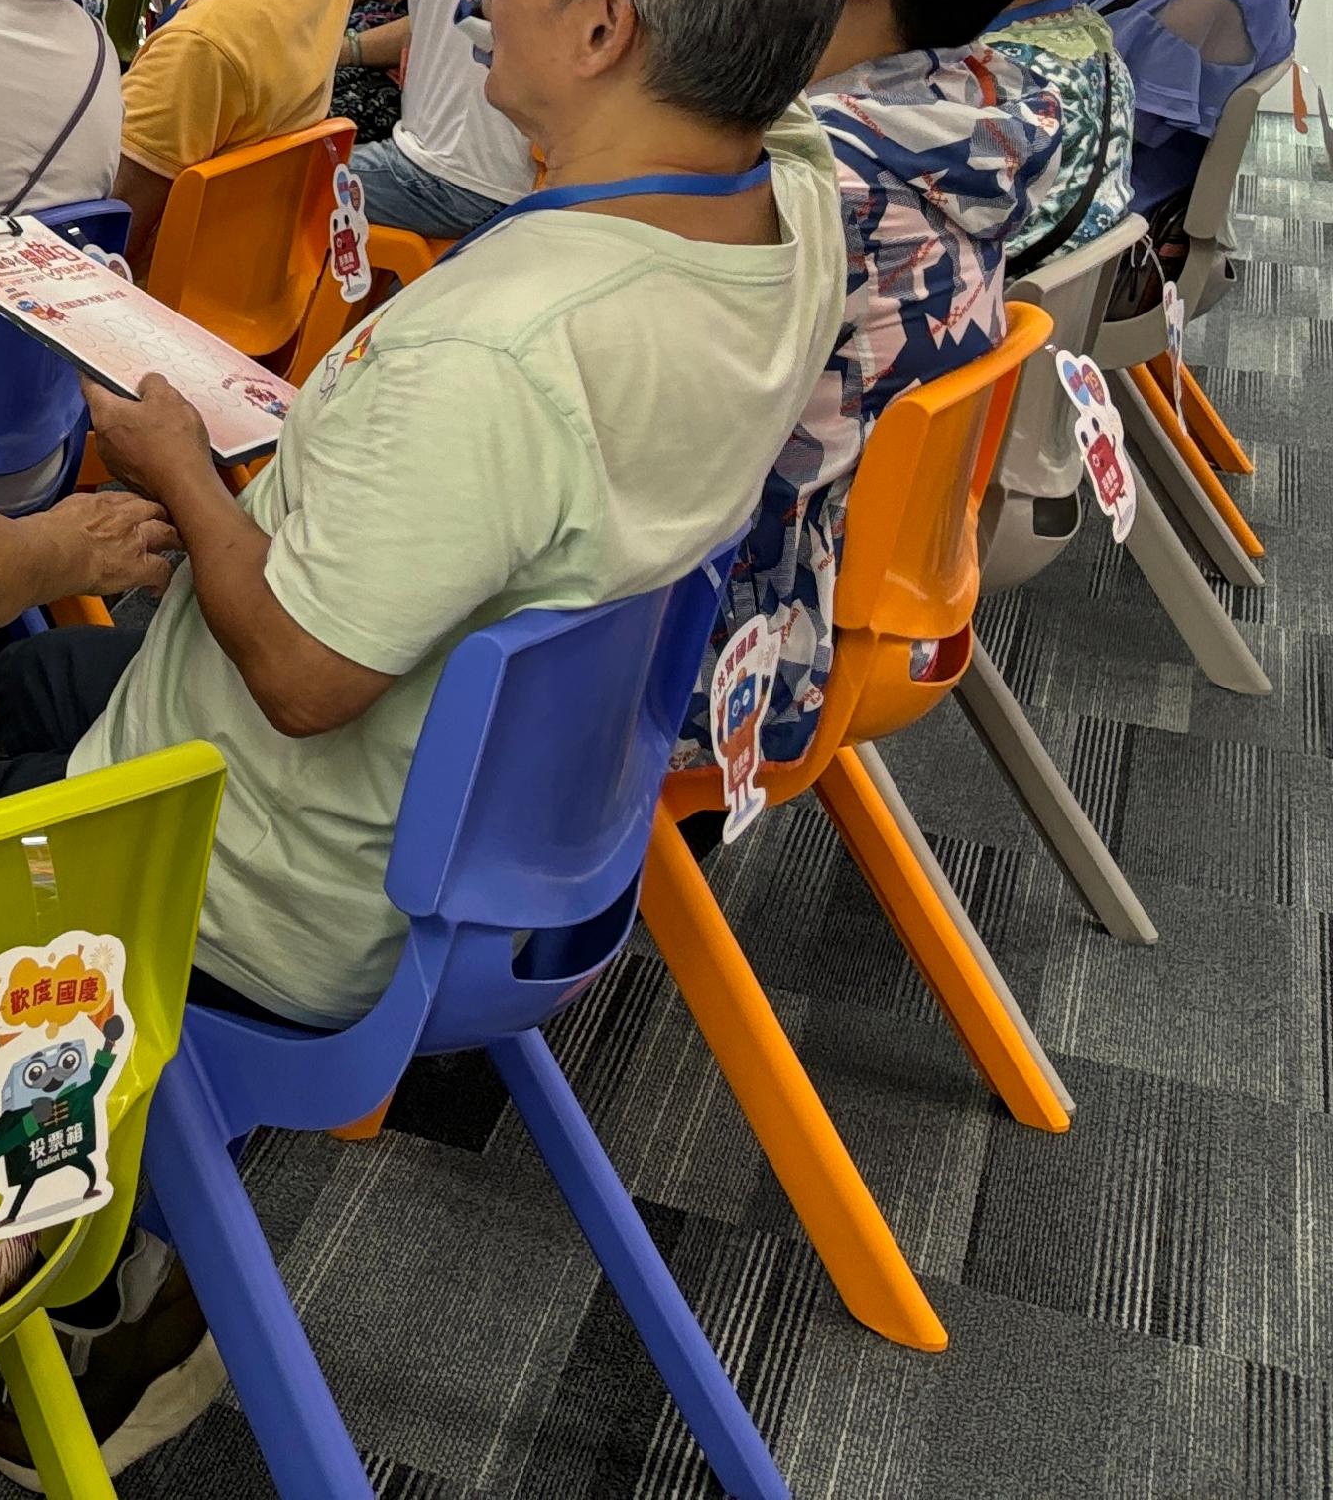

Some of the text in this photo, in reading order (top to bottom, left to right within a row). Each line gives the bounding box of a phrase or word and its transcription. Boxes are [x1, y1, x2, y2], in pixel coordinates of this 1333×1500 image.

[18, 241, 81, 269] 開放日
[9, 976, 99, 1016] 歡度國慶
[29, 1122, 84, 1162] 投票箱
[36, 1146, 79, 1170] Ballot Box
